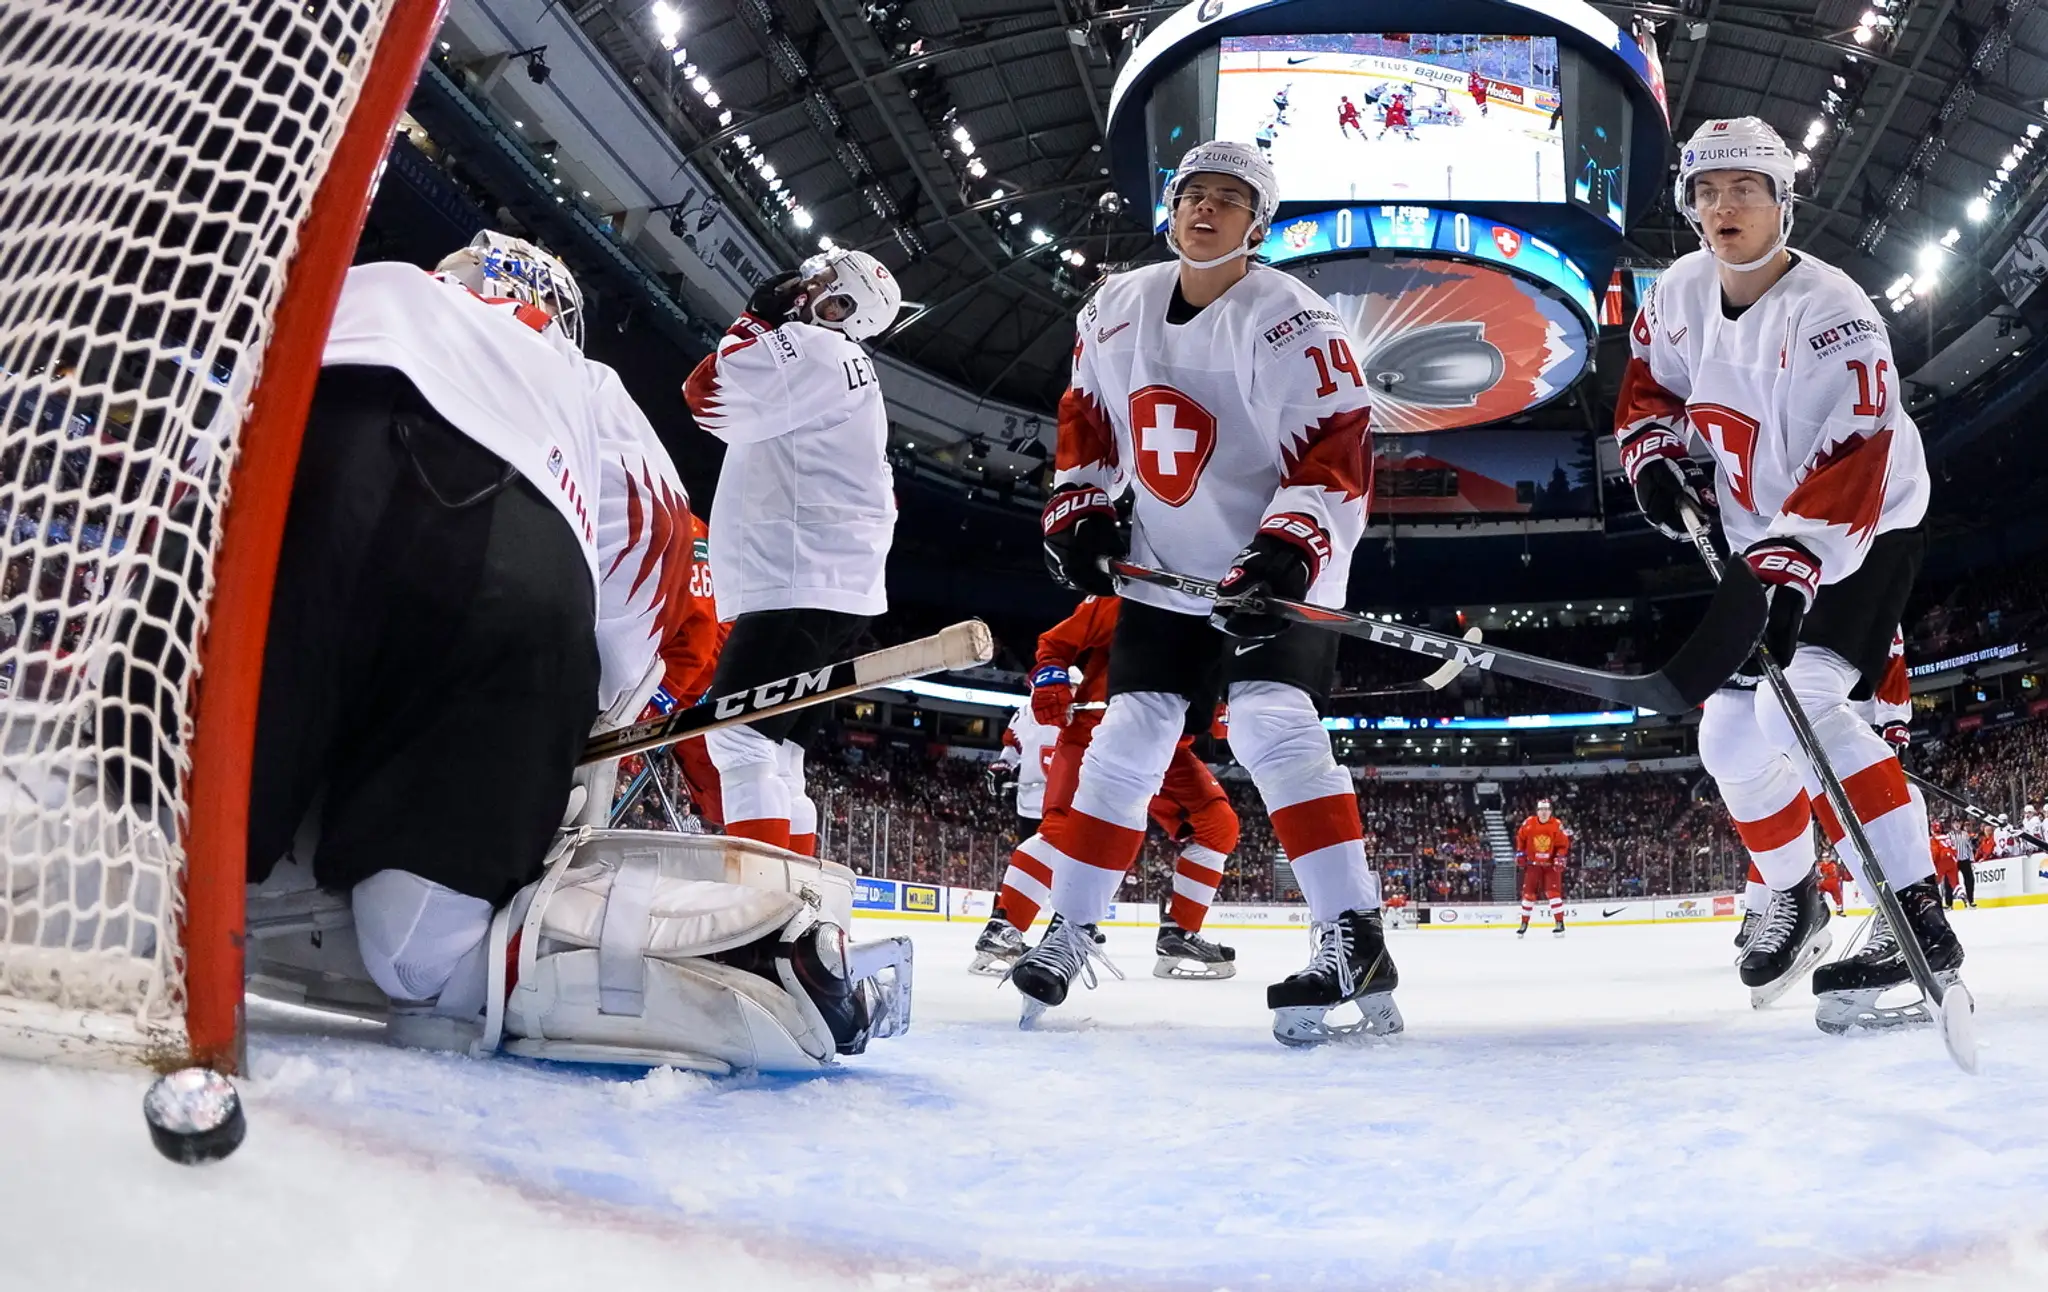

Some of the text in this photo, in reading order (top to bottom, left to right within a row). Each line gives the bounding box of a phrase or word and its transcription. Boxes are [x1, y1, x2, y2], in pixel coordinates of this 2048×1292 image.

[1374, 60, 1408, 72] TELUS
[1414, 66, 1464, 85] BAUER
[1204, 152, 1249, 168] ZURICH
[1700, 148, 1748, 160] ZURICH
[1336, 208, 1352, 249] 0
[1454, 213, 1471, 253] 0
[1289, 309, 1339, 327] TISSO
[1837, 318, 1878, 336] TISS
[773, 327, 798, 359] SSOT
[1272, 334, 1296, 352] SWISS
[1816, 344, 1843, 360] SWISS
[1303, 338, 1364, 399] 14
[1846, 358, 1888, 418] 16
[1044, 493, 1116, 534] BAUE
[1260, 517, 1329, 571] BAUE
[689, 564, 713, 598] 26
[1758, 555, 1819, 590] BAU
[1170, 578, 1218, 599] JETS
[1369, 624, 1496, 671] CCM
[1035, 670, 1067, 683] CC
[1914, 663, 1936, 677] FIERS
[714, 665, 835, 720] CCM
[1975, 868, 2006, 883] TISSOT
[1219, 911, 1268, 920] VANCOUVER
[1540, 909, 1578, 917] TEUS
